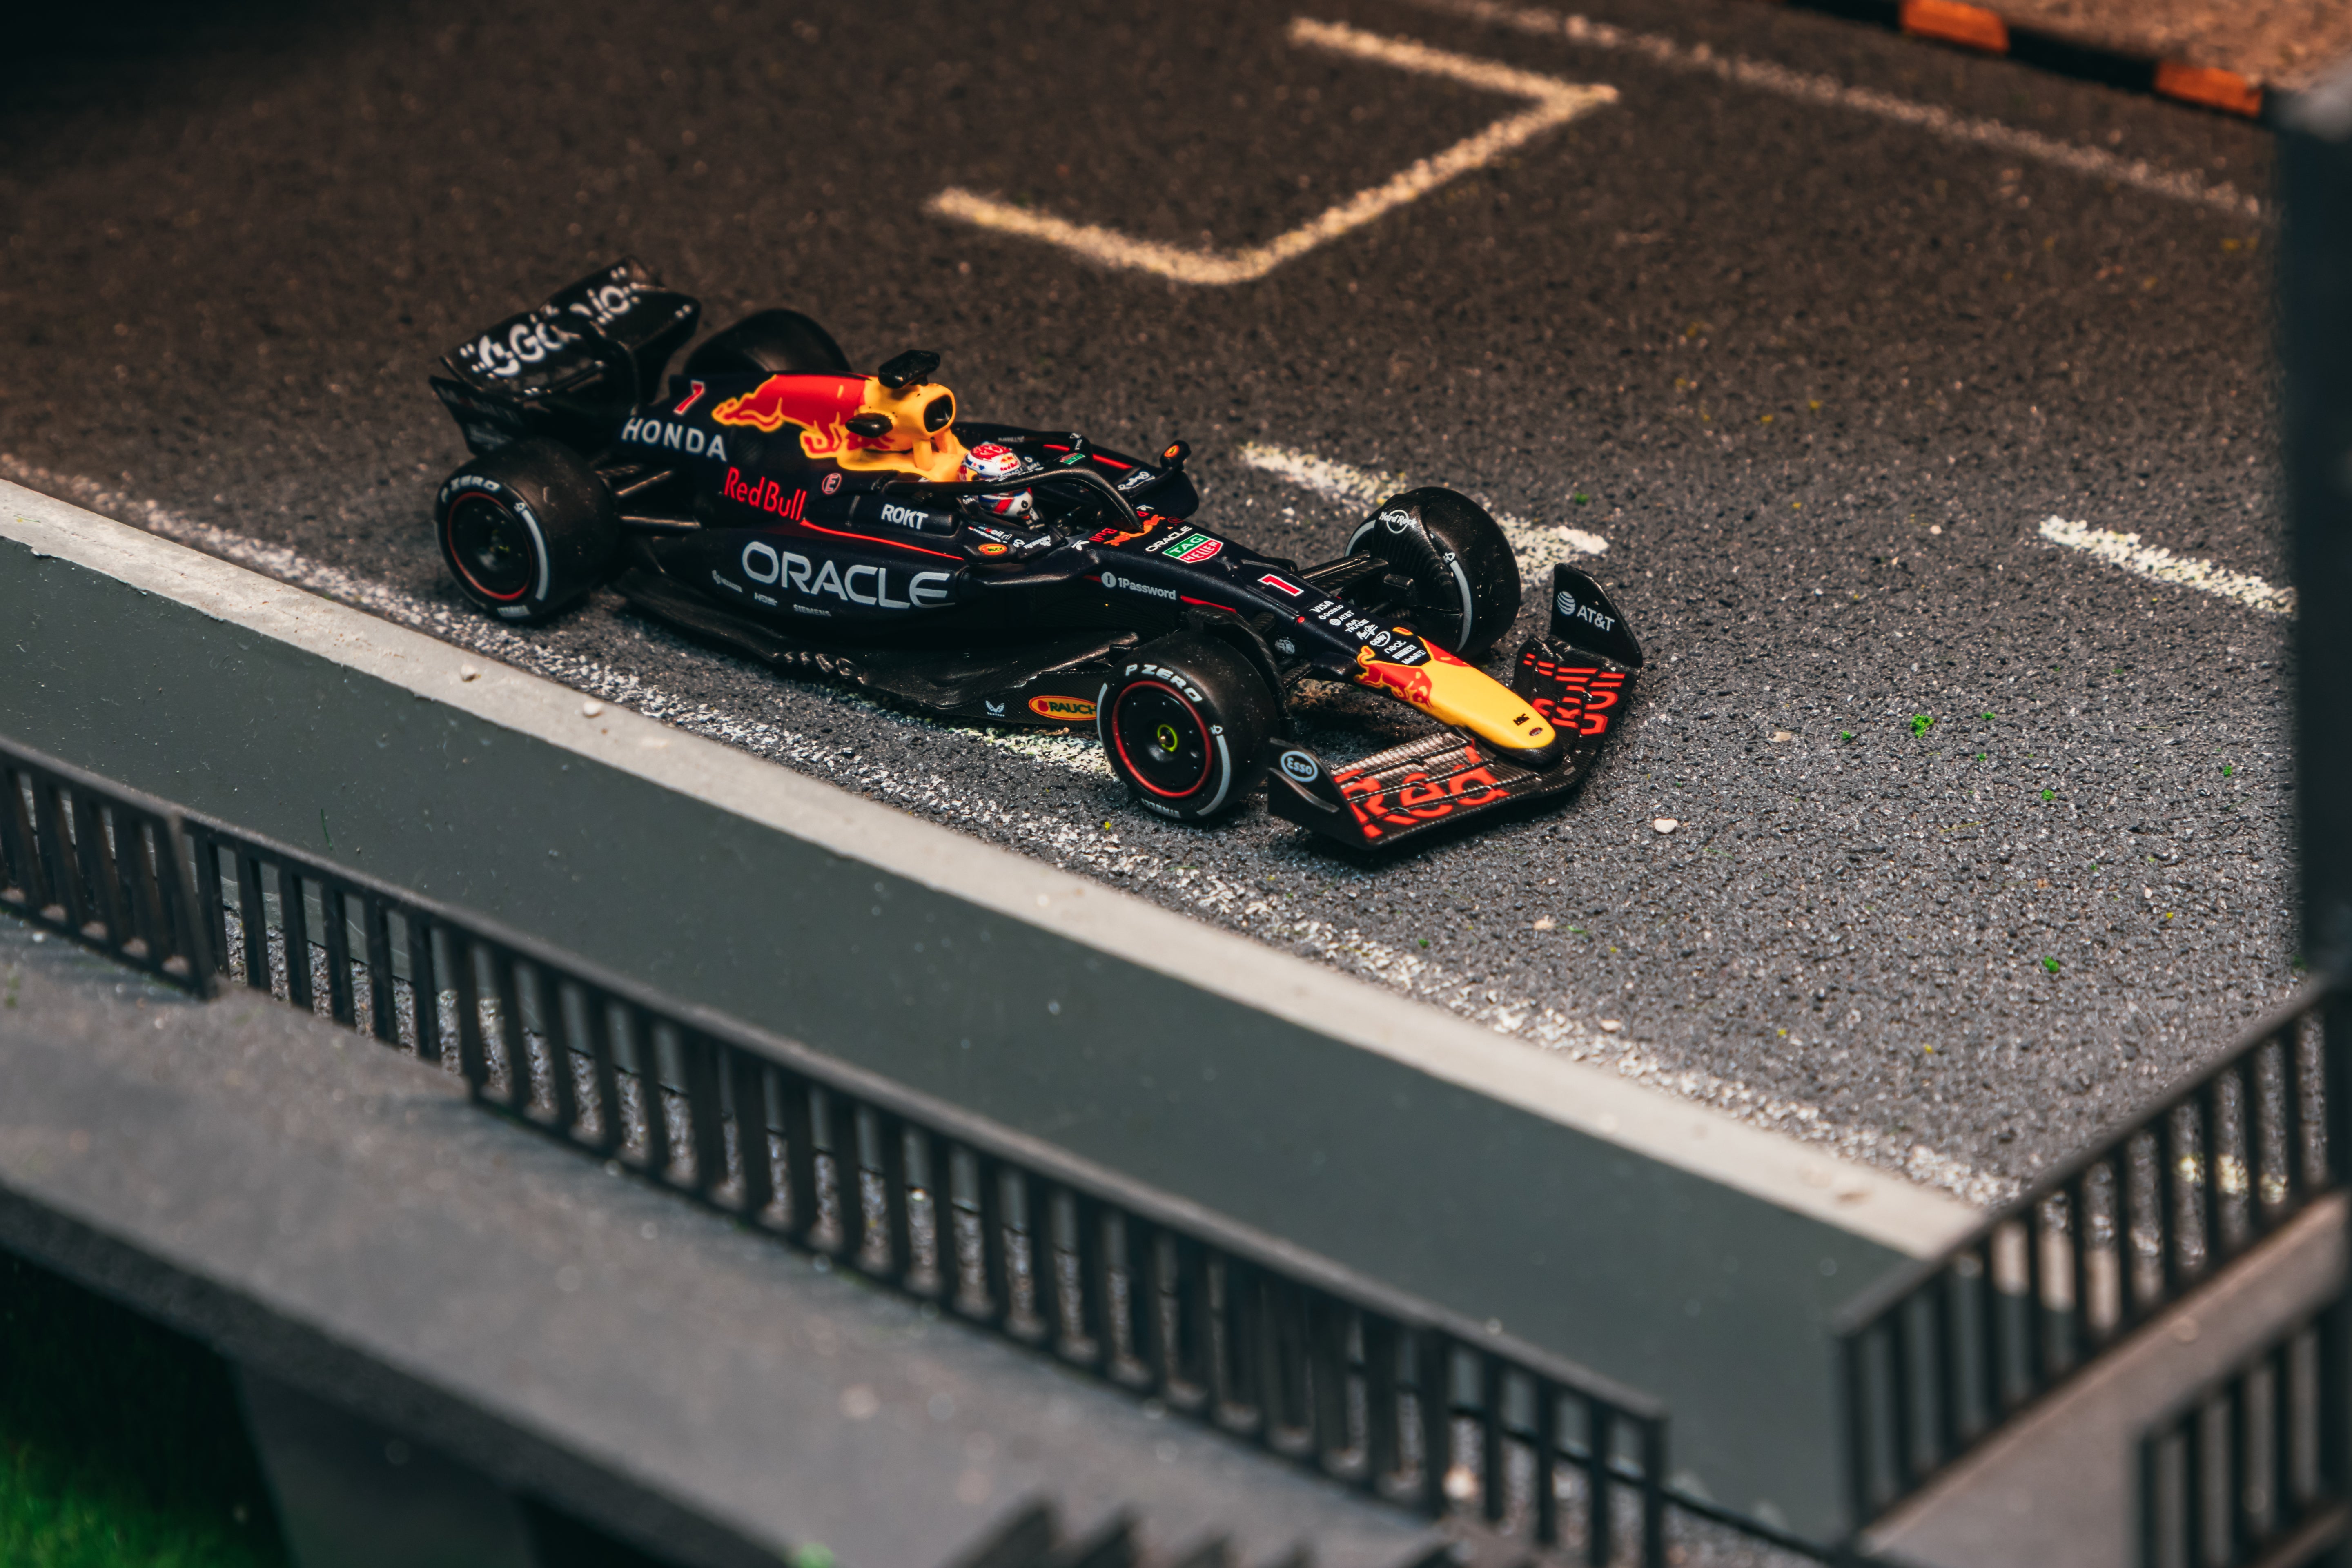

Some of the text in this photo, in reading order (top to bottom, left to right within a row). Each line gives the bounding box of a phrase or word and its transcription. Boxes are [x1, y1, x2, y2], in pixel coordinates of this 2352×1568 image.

[621, 417, 728, 462] HONDA
[881, 503, 929, 530] ROKT
[1379, 512, 1417, 528] Hard Rock
[1145, 526, 1192, 552] ORACLE
[1169, 537, 1204, 553] TAG
[742, 541, 956, 608] ORACLE
[1258, 573, 1304, 597] 1
[1118, 577, 1177, 600] 1Password
[793, 604, 831, 617] SIEMENS
[1308, 601, 1334, 612] VISA
[1338, 610, 1354, 621] AT&T
[1577, 605, 1615, 631] AT&T
[1345, 619, 1370, 633] TRADE
[1125, 663, 1203, 702] P ZERO
[1287, 757, 1312, 775] Esso
[1333, 738, 1510, 838] Red
